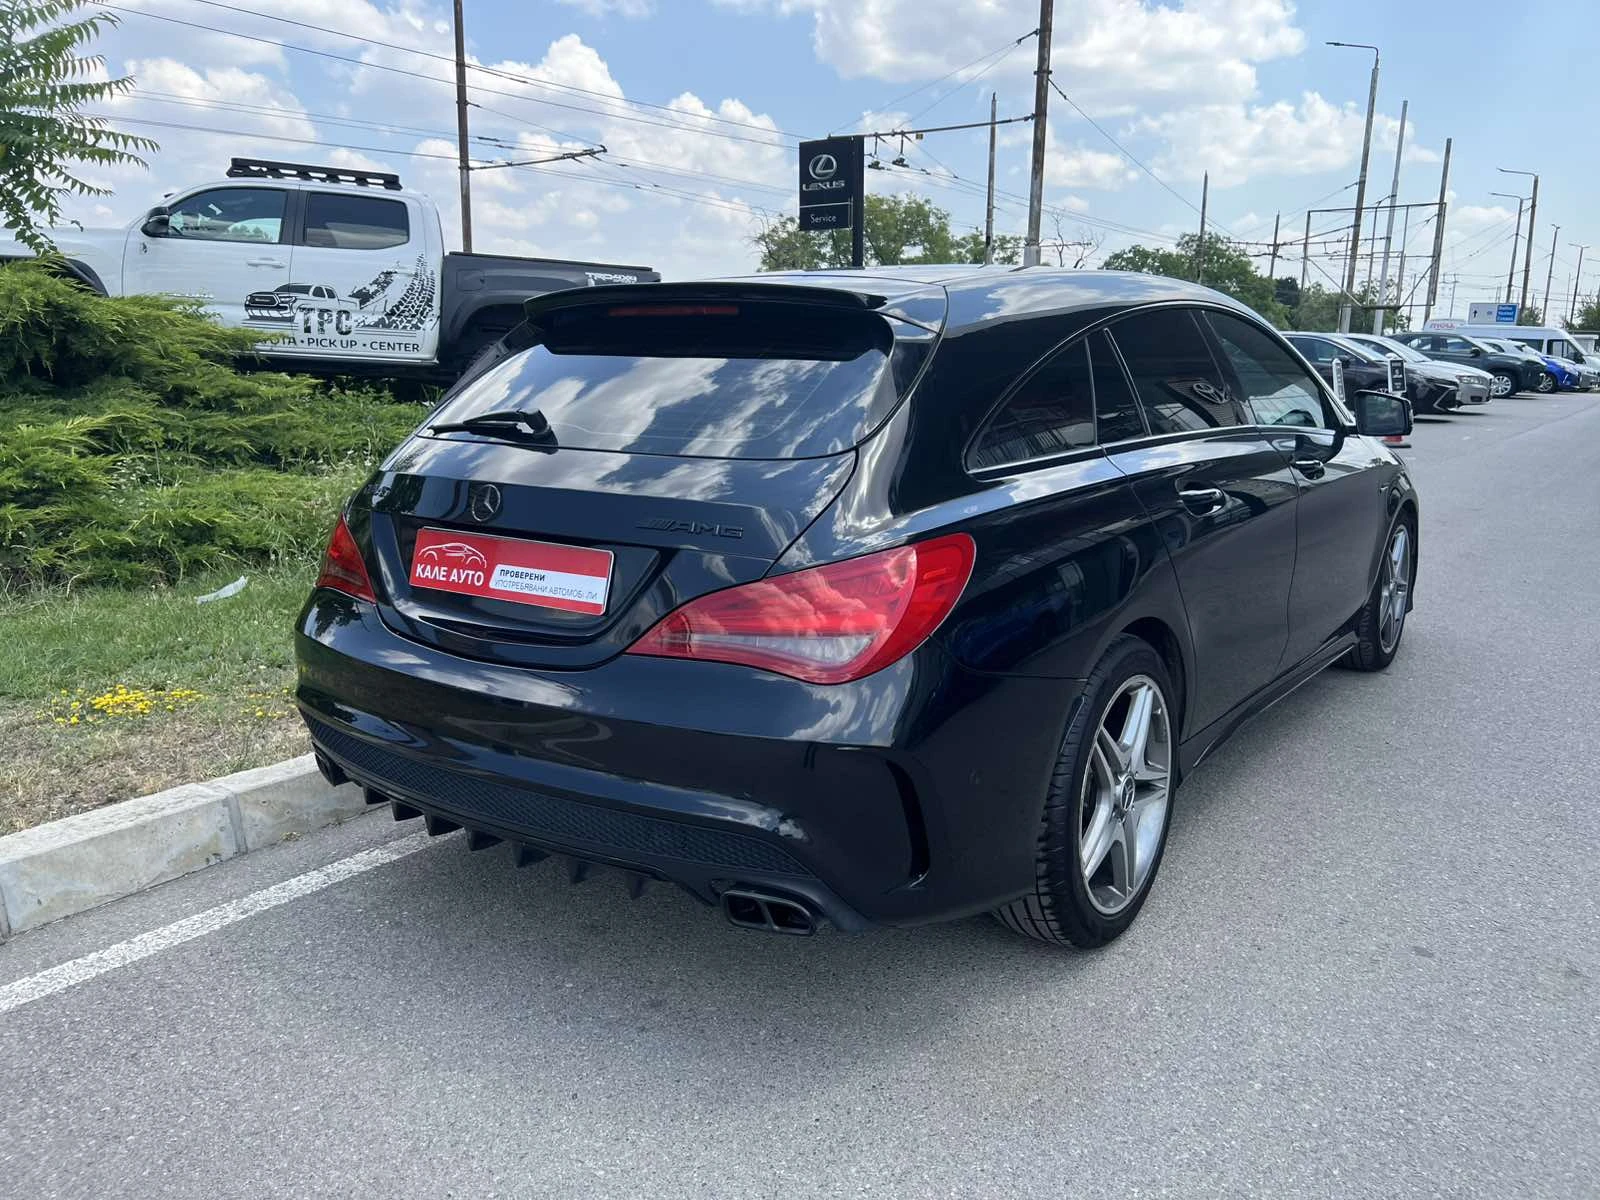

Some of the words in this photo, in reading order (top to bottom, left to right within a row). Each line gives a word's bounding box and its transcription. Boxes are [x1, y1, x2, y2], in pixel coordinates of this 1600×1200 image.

[802, 179, 845, 192] LEXUS
[810, 213, 837, 224] Service
[299, 307, 353, 336] TPC
[307, 337, 336, 348] PICK
[340, 339, 358, 349] UP
[370, 341, 420, 353] CENTER
[415, 563, 448, 582] КАЛЕ
[449, 568, 485, 587] АУТО
[499, 569, 546, 582] ПРОВЕРЕНИ
[549, 586, 598, 600] АВТОМОБЛИ
